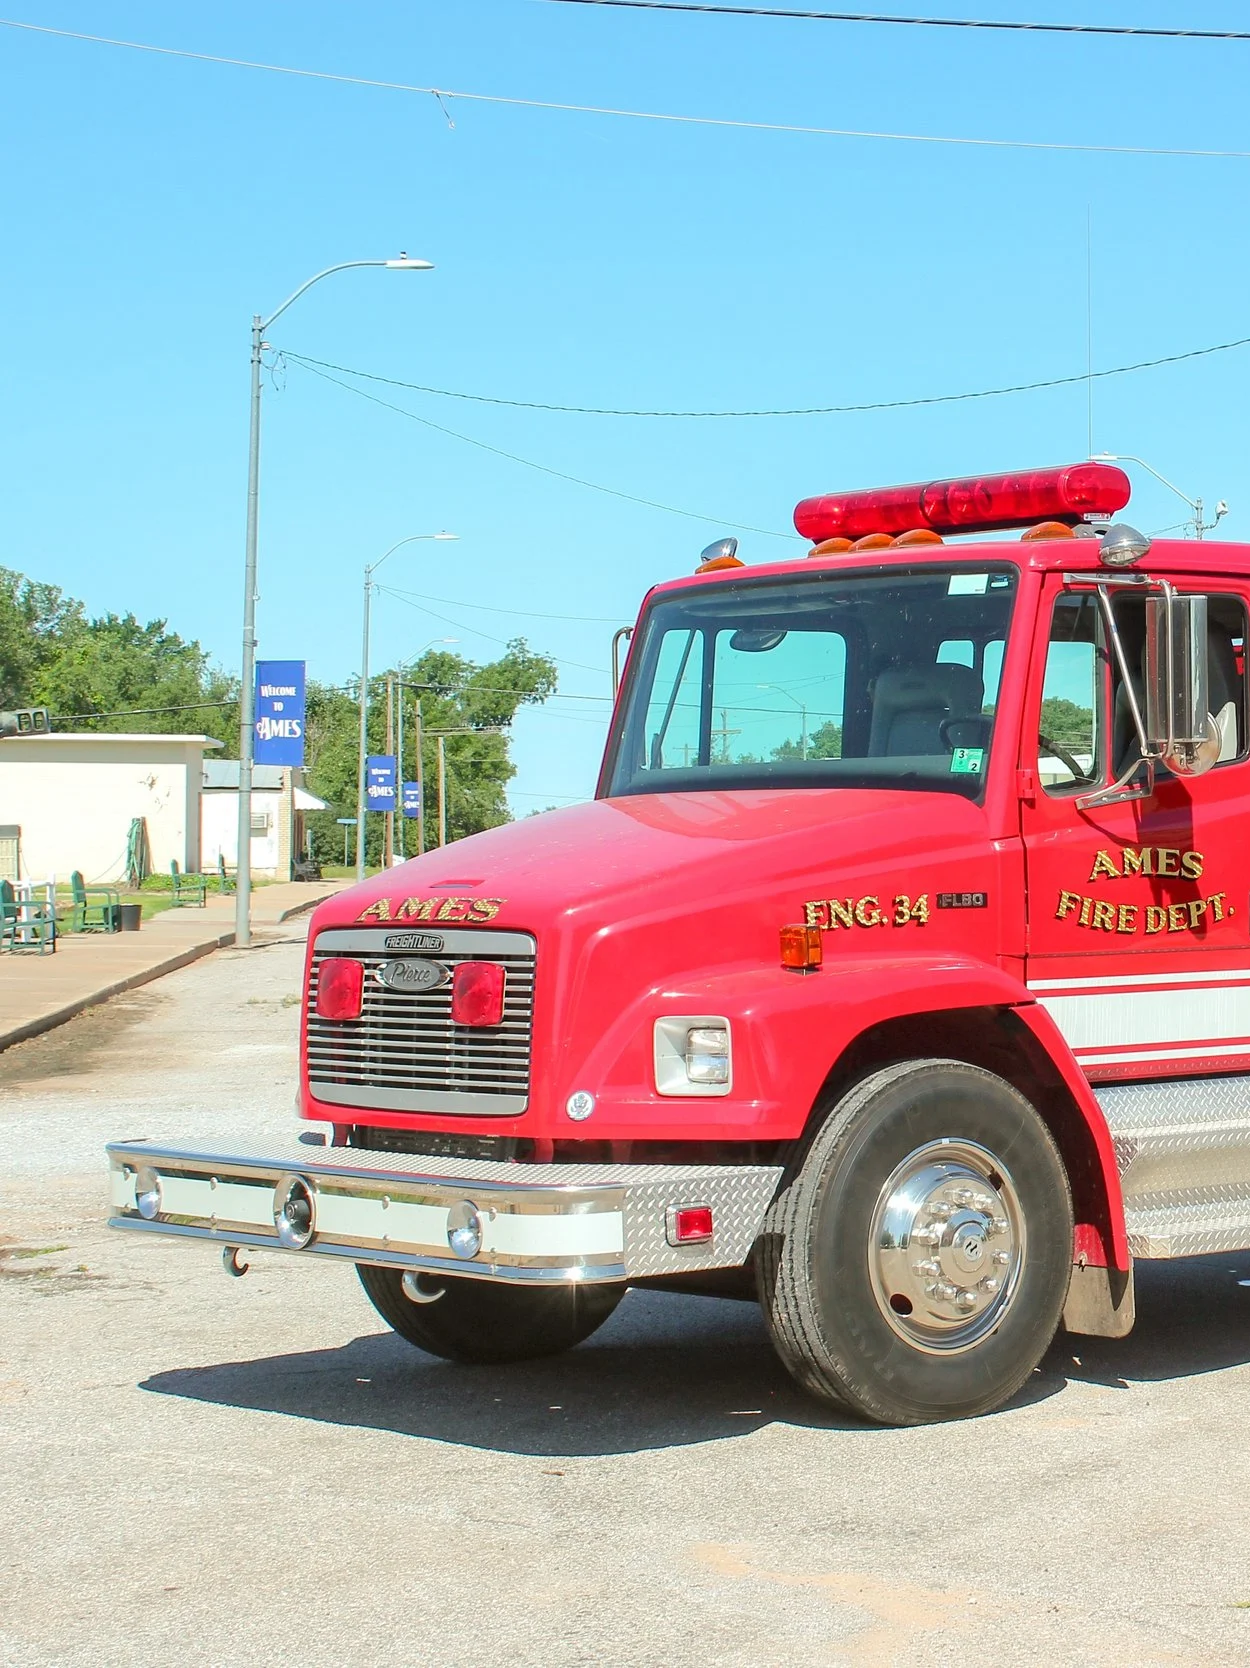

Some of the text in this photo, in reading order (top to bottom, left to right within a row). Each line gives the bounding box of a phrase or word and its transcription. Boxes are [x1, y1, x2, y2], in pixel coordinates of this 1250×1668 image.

[256, 716, 302, 740] AMES
[958, 750, 965, 759] 3
[971, 763, 977, 771] 2
[1087, 847, 1205, 883] AMES
[354, 897, 507, 923] AMES
[802, 893, 931, 930] ENG. 34
[1055, 889, 1236, 934] FIRE DEPT.
[386, 934, 440, 949] FREIGHTLINER
[390, 962, 431, 984] Pierce
